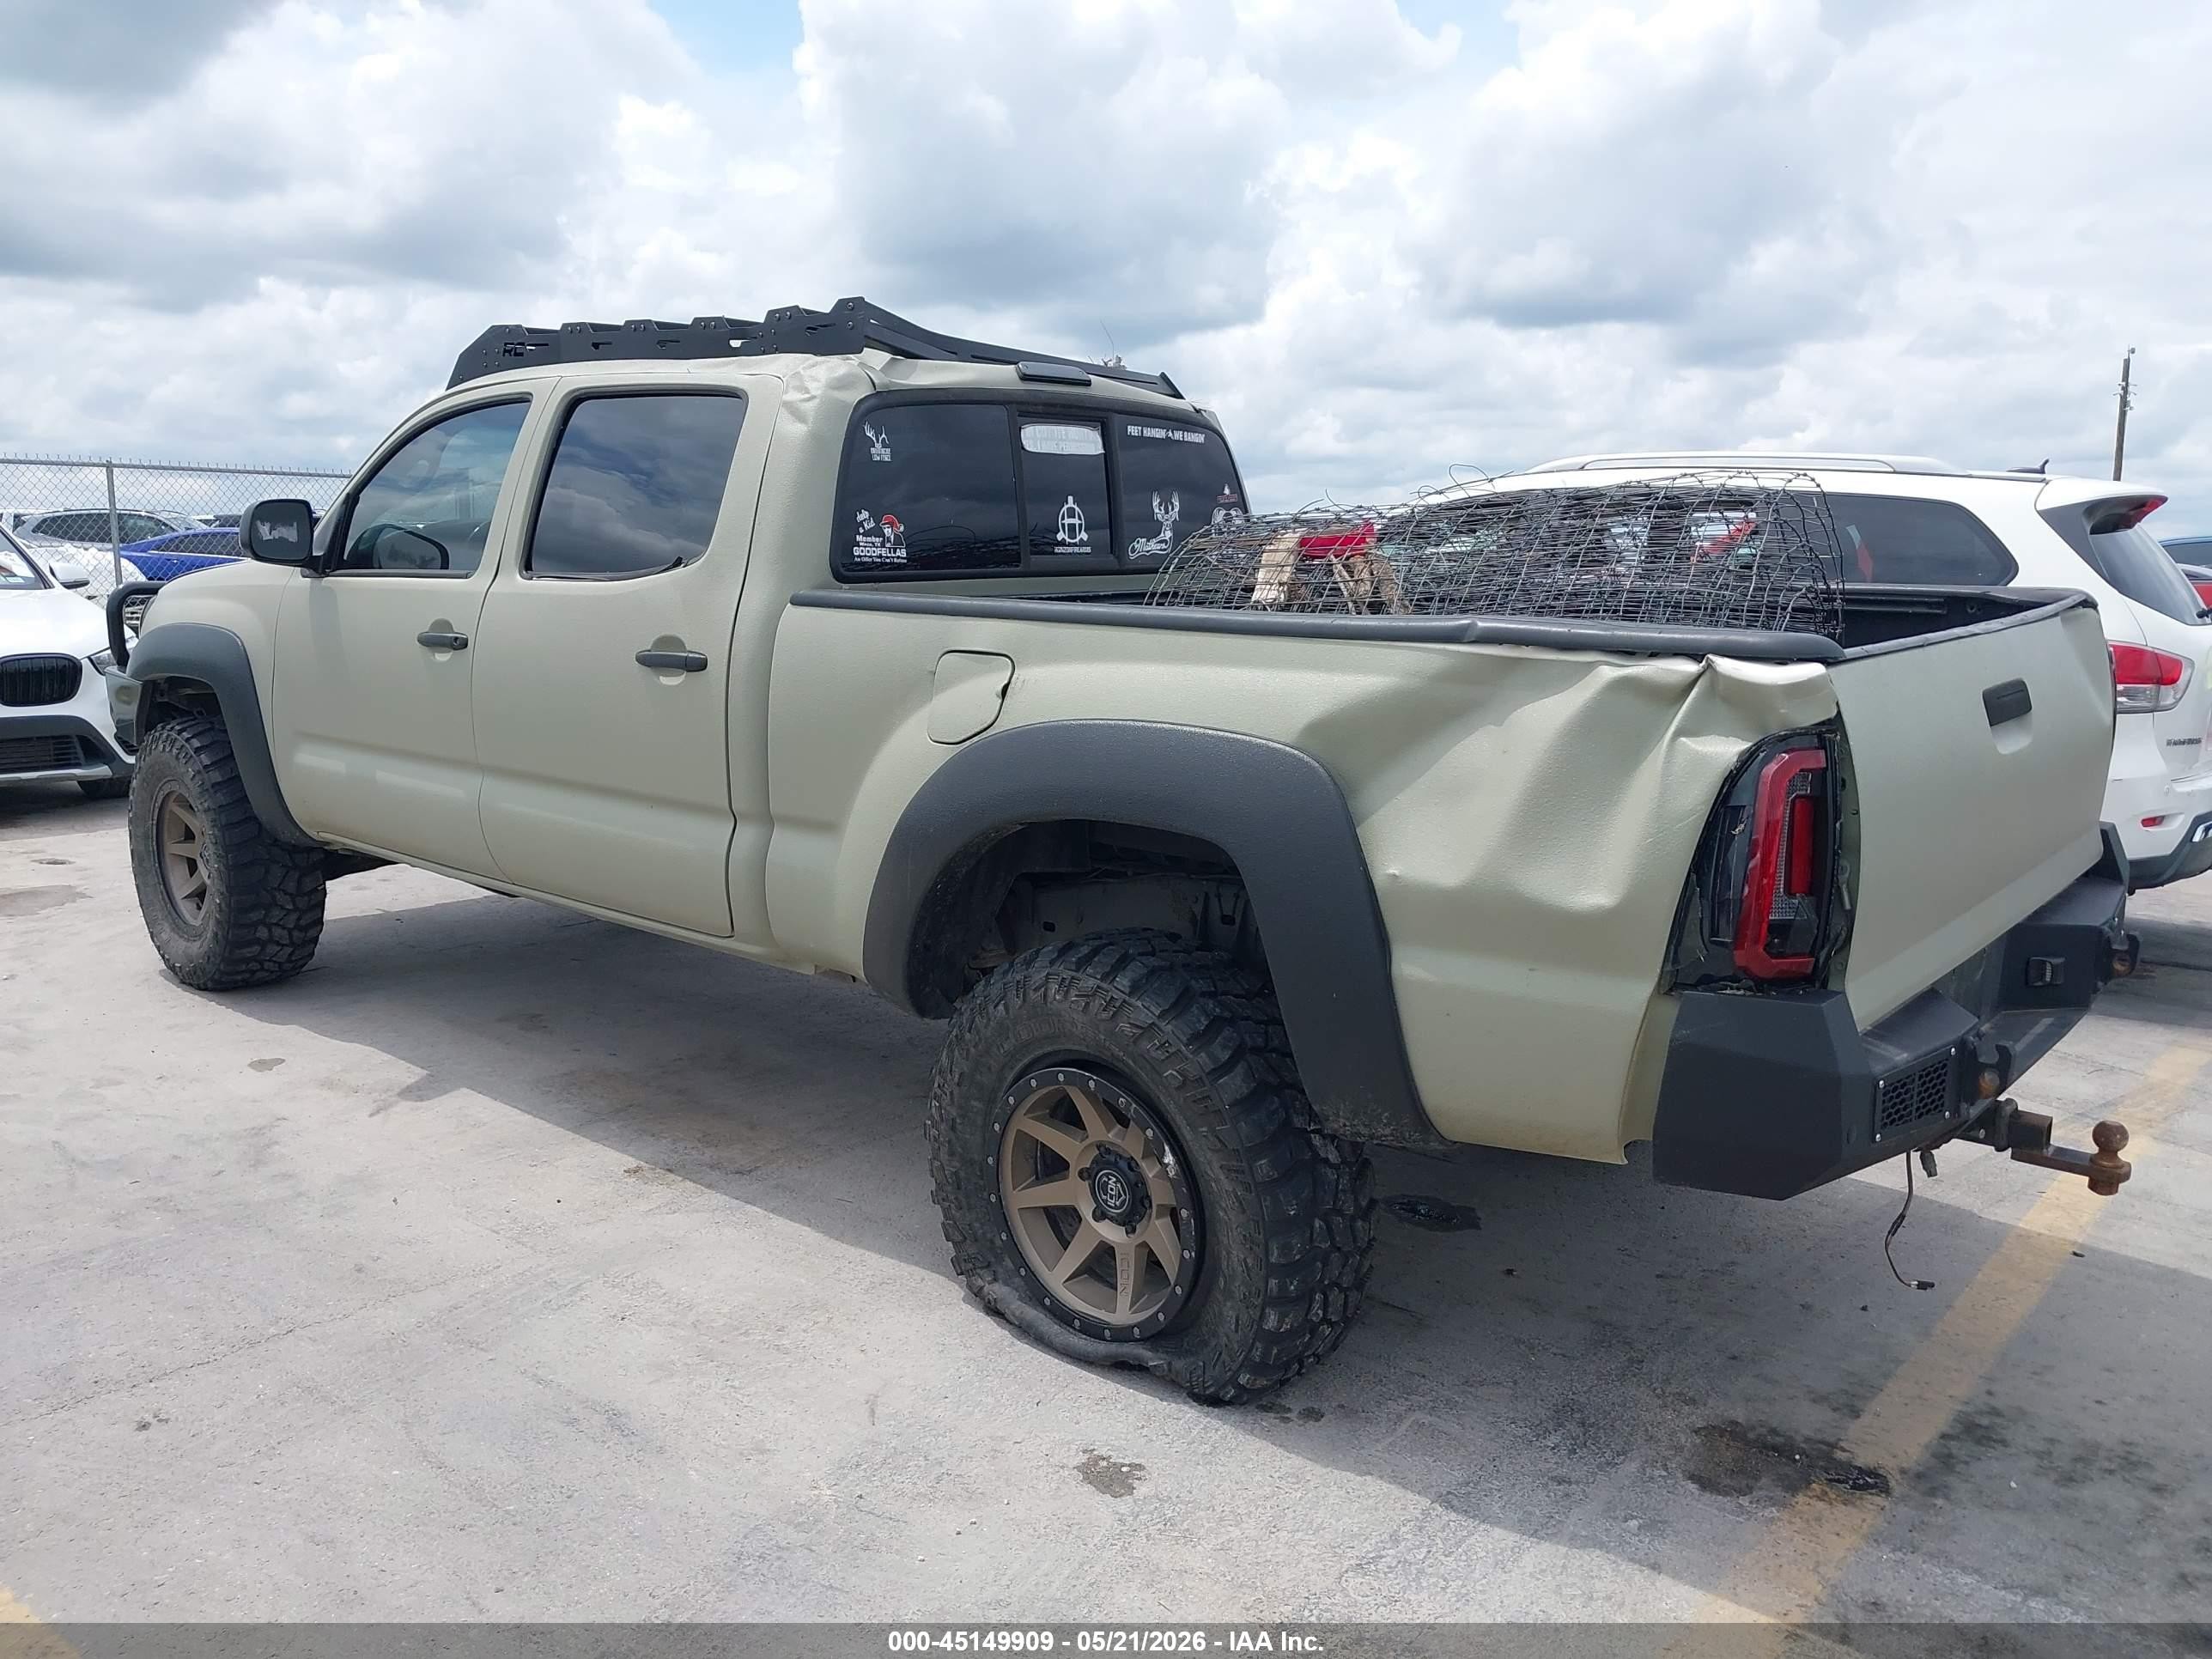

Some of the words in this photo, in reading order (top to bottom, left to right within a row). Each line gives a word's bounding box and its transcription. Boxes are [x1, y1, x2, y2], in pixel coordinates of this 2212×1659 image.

[1127, 425, 1142, 436] FEET
[1173, 430, 1183, 441] WE
[863, 517, 876, 531] Kid
[855, 534, 884, 543] Member
[853, 546, 907, 557] GOODFELLAS
[1107, 1175, 1117, 1207] ICON
